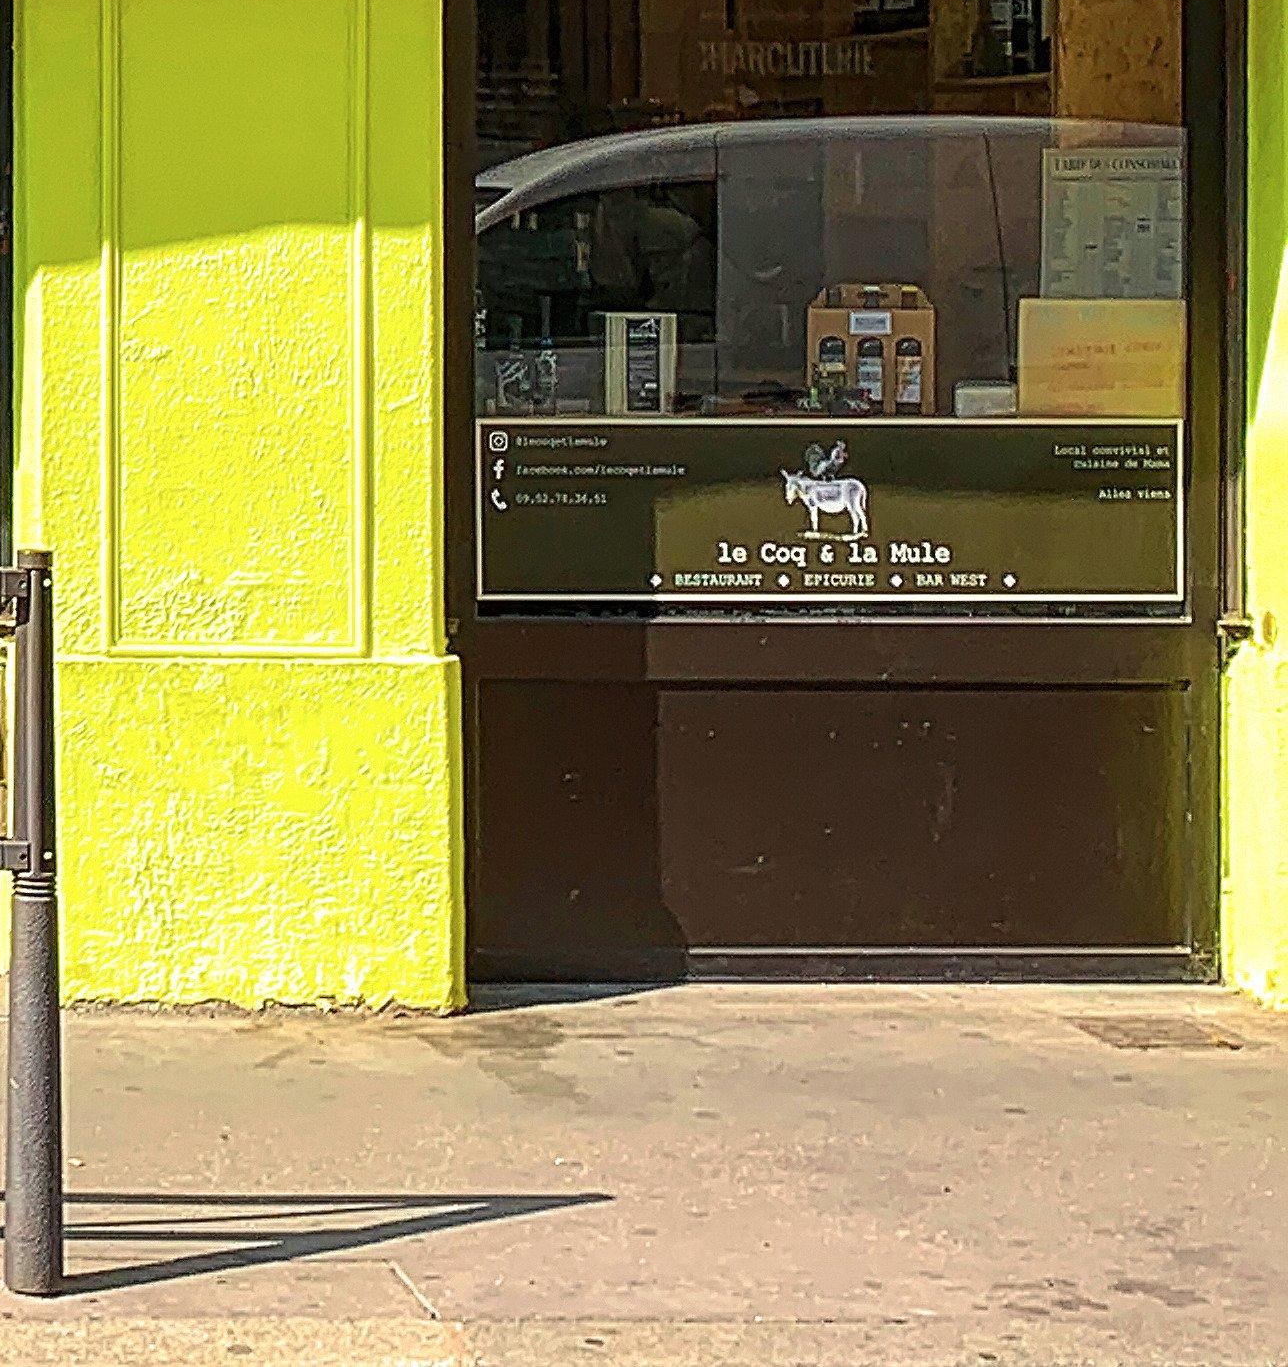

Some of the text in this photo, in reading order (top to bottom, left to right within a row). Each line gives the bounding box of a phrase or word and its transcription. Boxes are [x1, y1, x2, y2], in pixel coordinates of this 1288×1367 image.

[1054, 445, 1169, 456] Local convivial et
[718, 541, 952, 568] le Coq & la Mule
[674, 573, 988, 587] RESTAURANT EPICURIE BAR WEST
